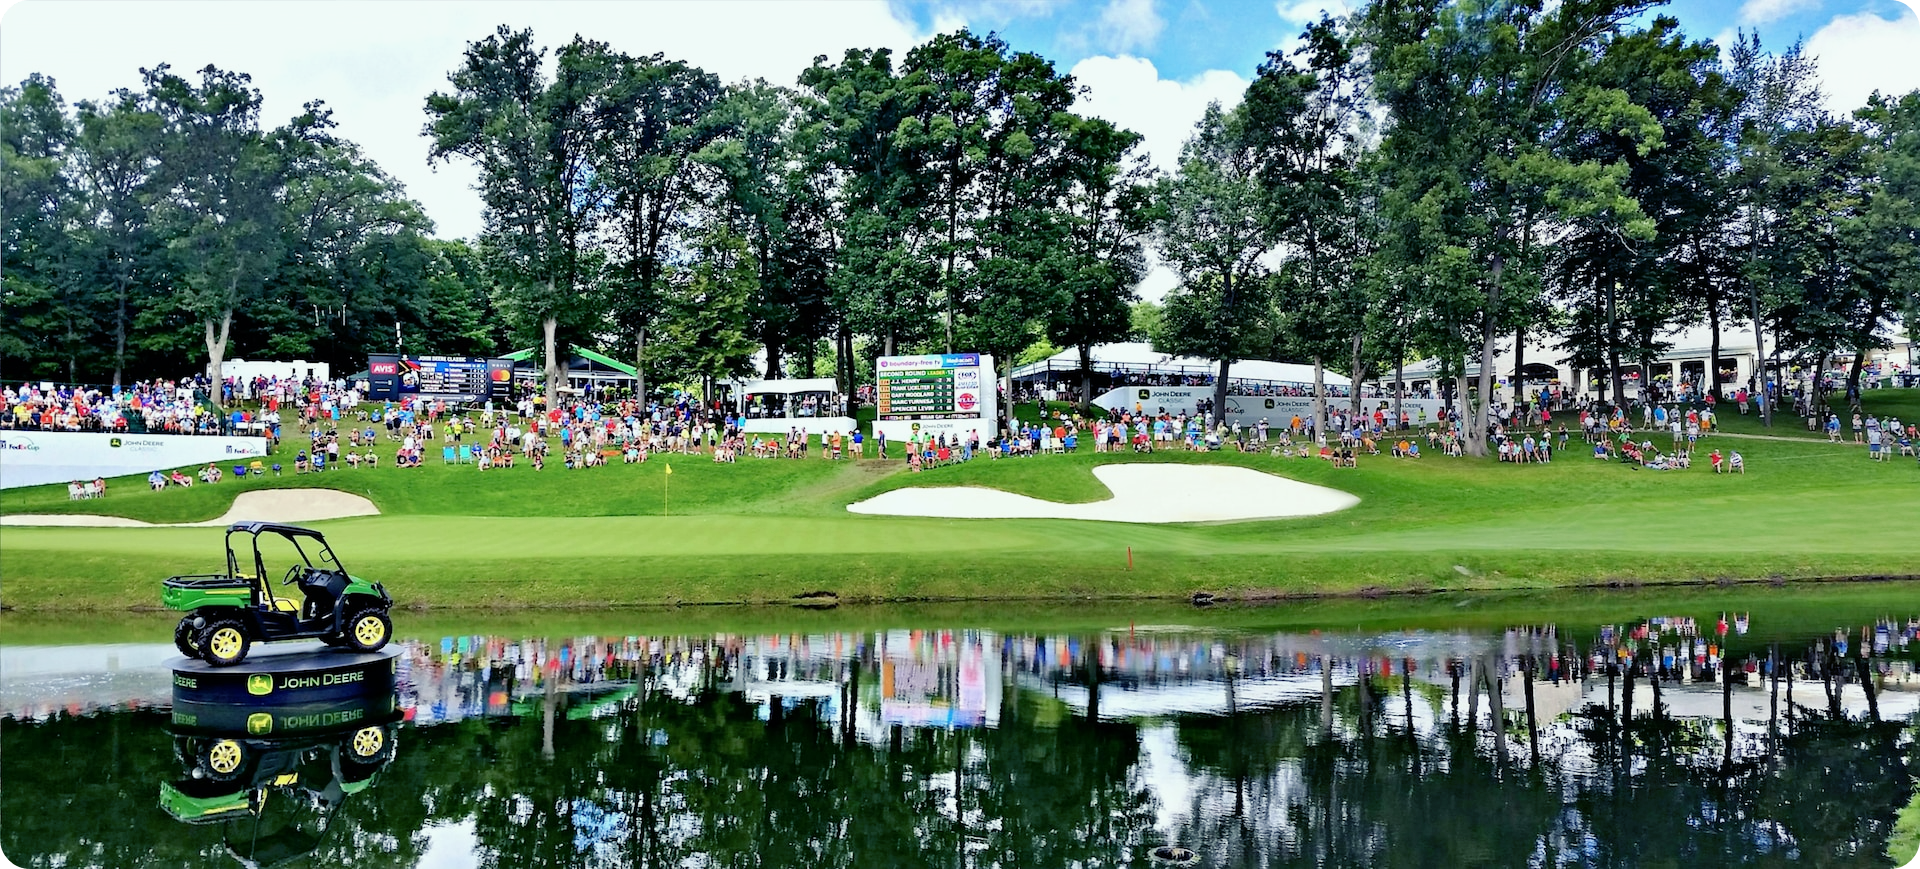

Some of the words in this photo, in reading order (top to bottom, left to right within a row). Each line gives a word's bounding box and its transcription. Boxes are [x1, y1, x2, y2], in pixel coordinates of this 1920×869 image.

[174, 674, 198, 688] DEERE
[279, 676, 320, 689] JOHN
[323, 671, 364, 686] DEERE
